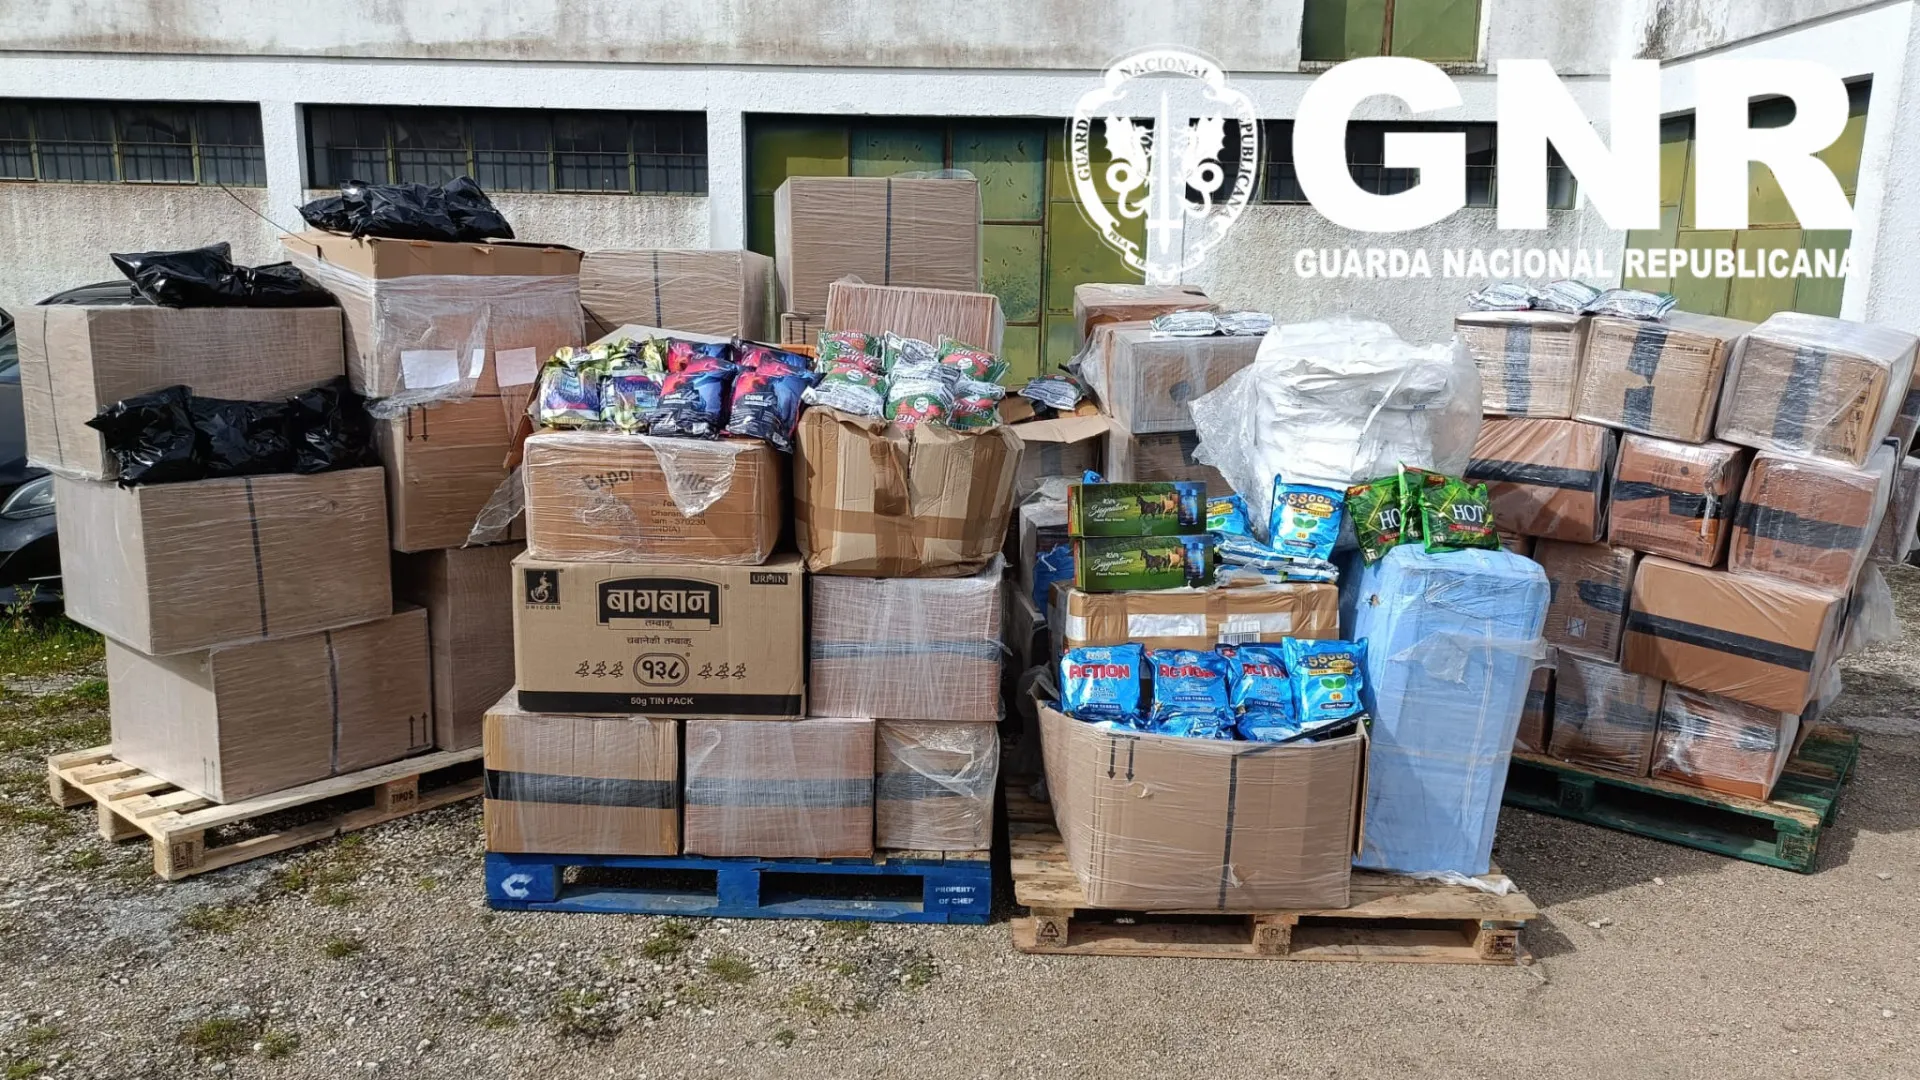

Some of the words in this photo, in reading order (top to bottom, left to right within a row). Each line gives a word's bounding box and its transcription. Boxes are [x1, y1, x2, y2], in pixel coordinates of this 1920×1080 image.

[1378, 507, 1401, 530] HO
[1452, 503, 1487, 524] HOT
[752, 574, 786, 583] URMIN
[606, 589, 711, 613] बागबान
[641, 660, 681, 680] १३८
[1069, 664, 1130, 680] ACTION
[630, 697, 648, 707] 50g
[649, 697, 665, 705] TIN
[666, 697, 695, 705] PACK
[951, 897, 974, 905] CHEP
